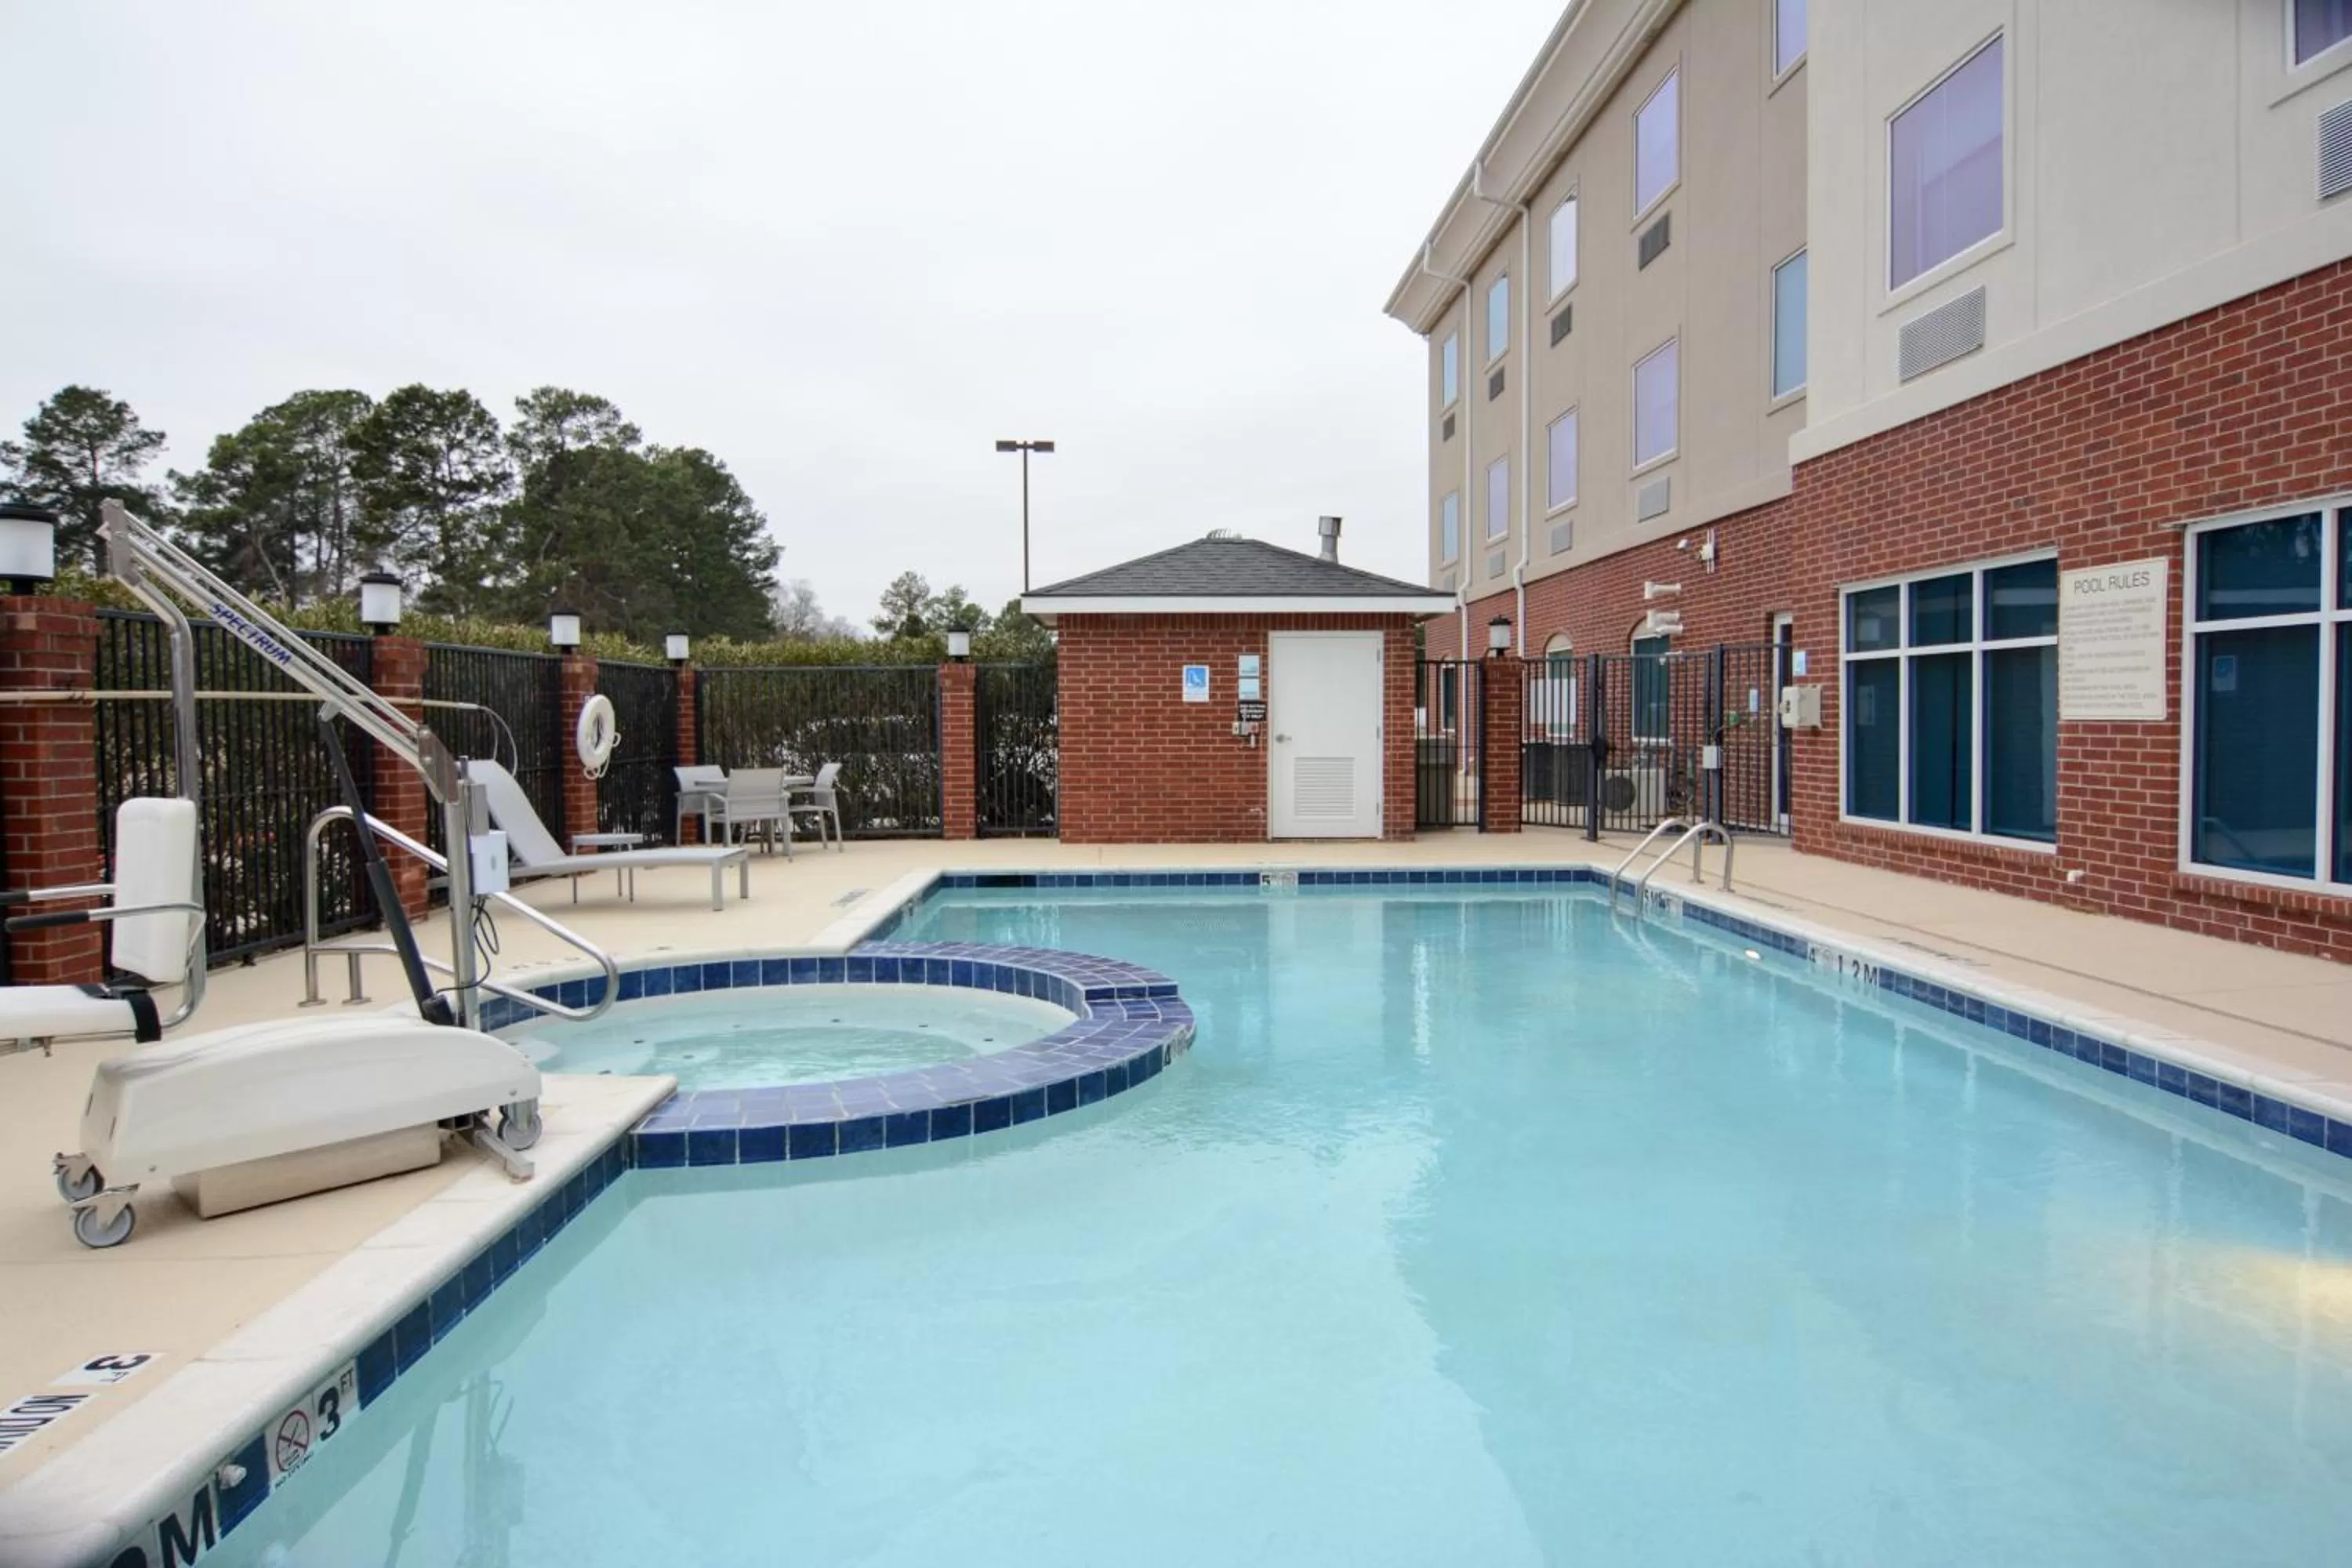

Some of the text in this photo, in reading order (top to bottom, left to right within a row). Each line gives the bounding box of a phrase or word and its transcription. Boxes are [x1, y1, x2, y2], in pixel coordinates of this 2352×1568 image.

[2074, 571, 2151, 595] POOL RULES
[209, 603, 292, 665] SPECTRUM
[84, 1354, 151, 1370] 3
[318, 1367, 354, 1443] 3 FT
